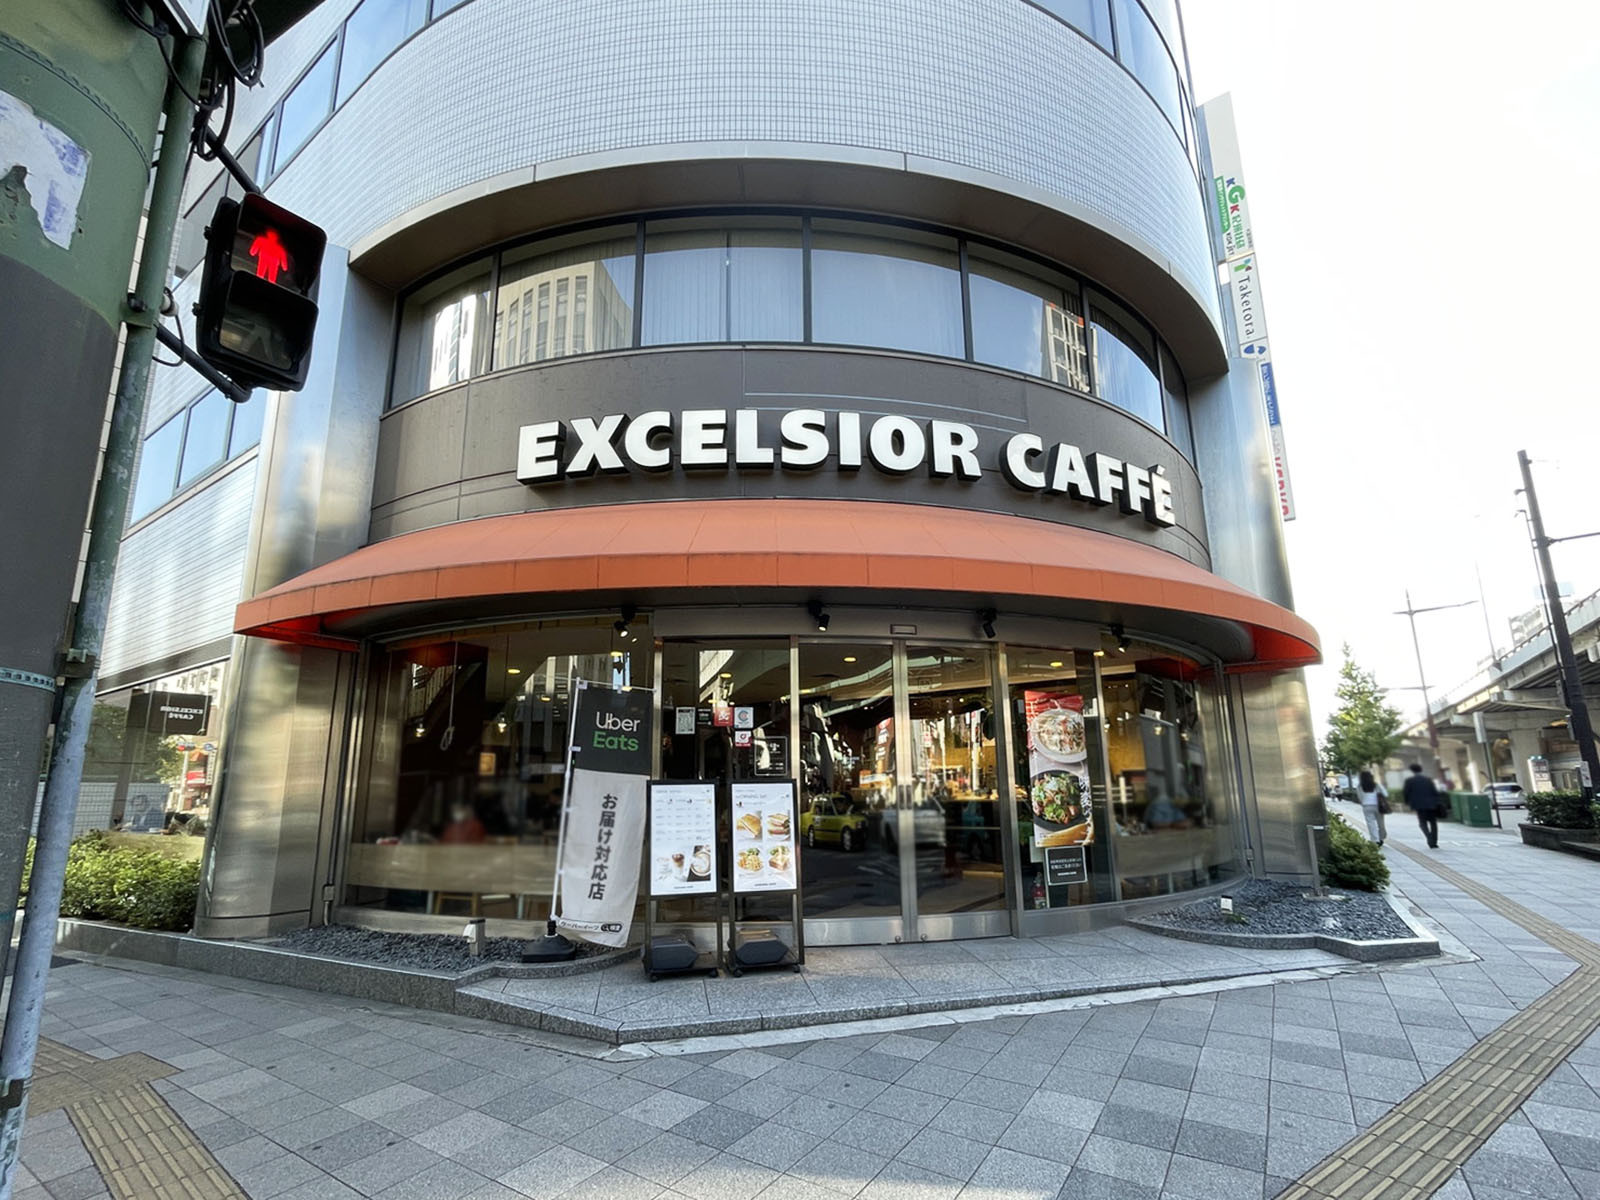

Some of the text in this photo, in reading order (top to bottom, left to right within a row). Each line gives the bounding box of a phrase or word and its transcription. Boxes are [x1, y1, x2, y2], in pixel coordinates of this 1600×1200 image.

[1226, 177, 1246, 215] KGK
[1238, 275, 1255, 337] Taketora
[516, 408, 982, 481] EXCELSIOR
[1004, 432, 1176, 528] CAFFÉ
[592, 730, 640, 752] Eats
[595, 711, 641, 732] Uber
[587, 793, 619, 901] お届け対応店
